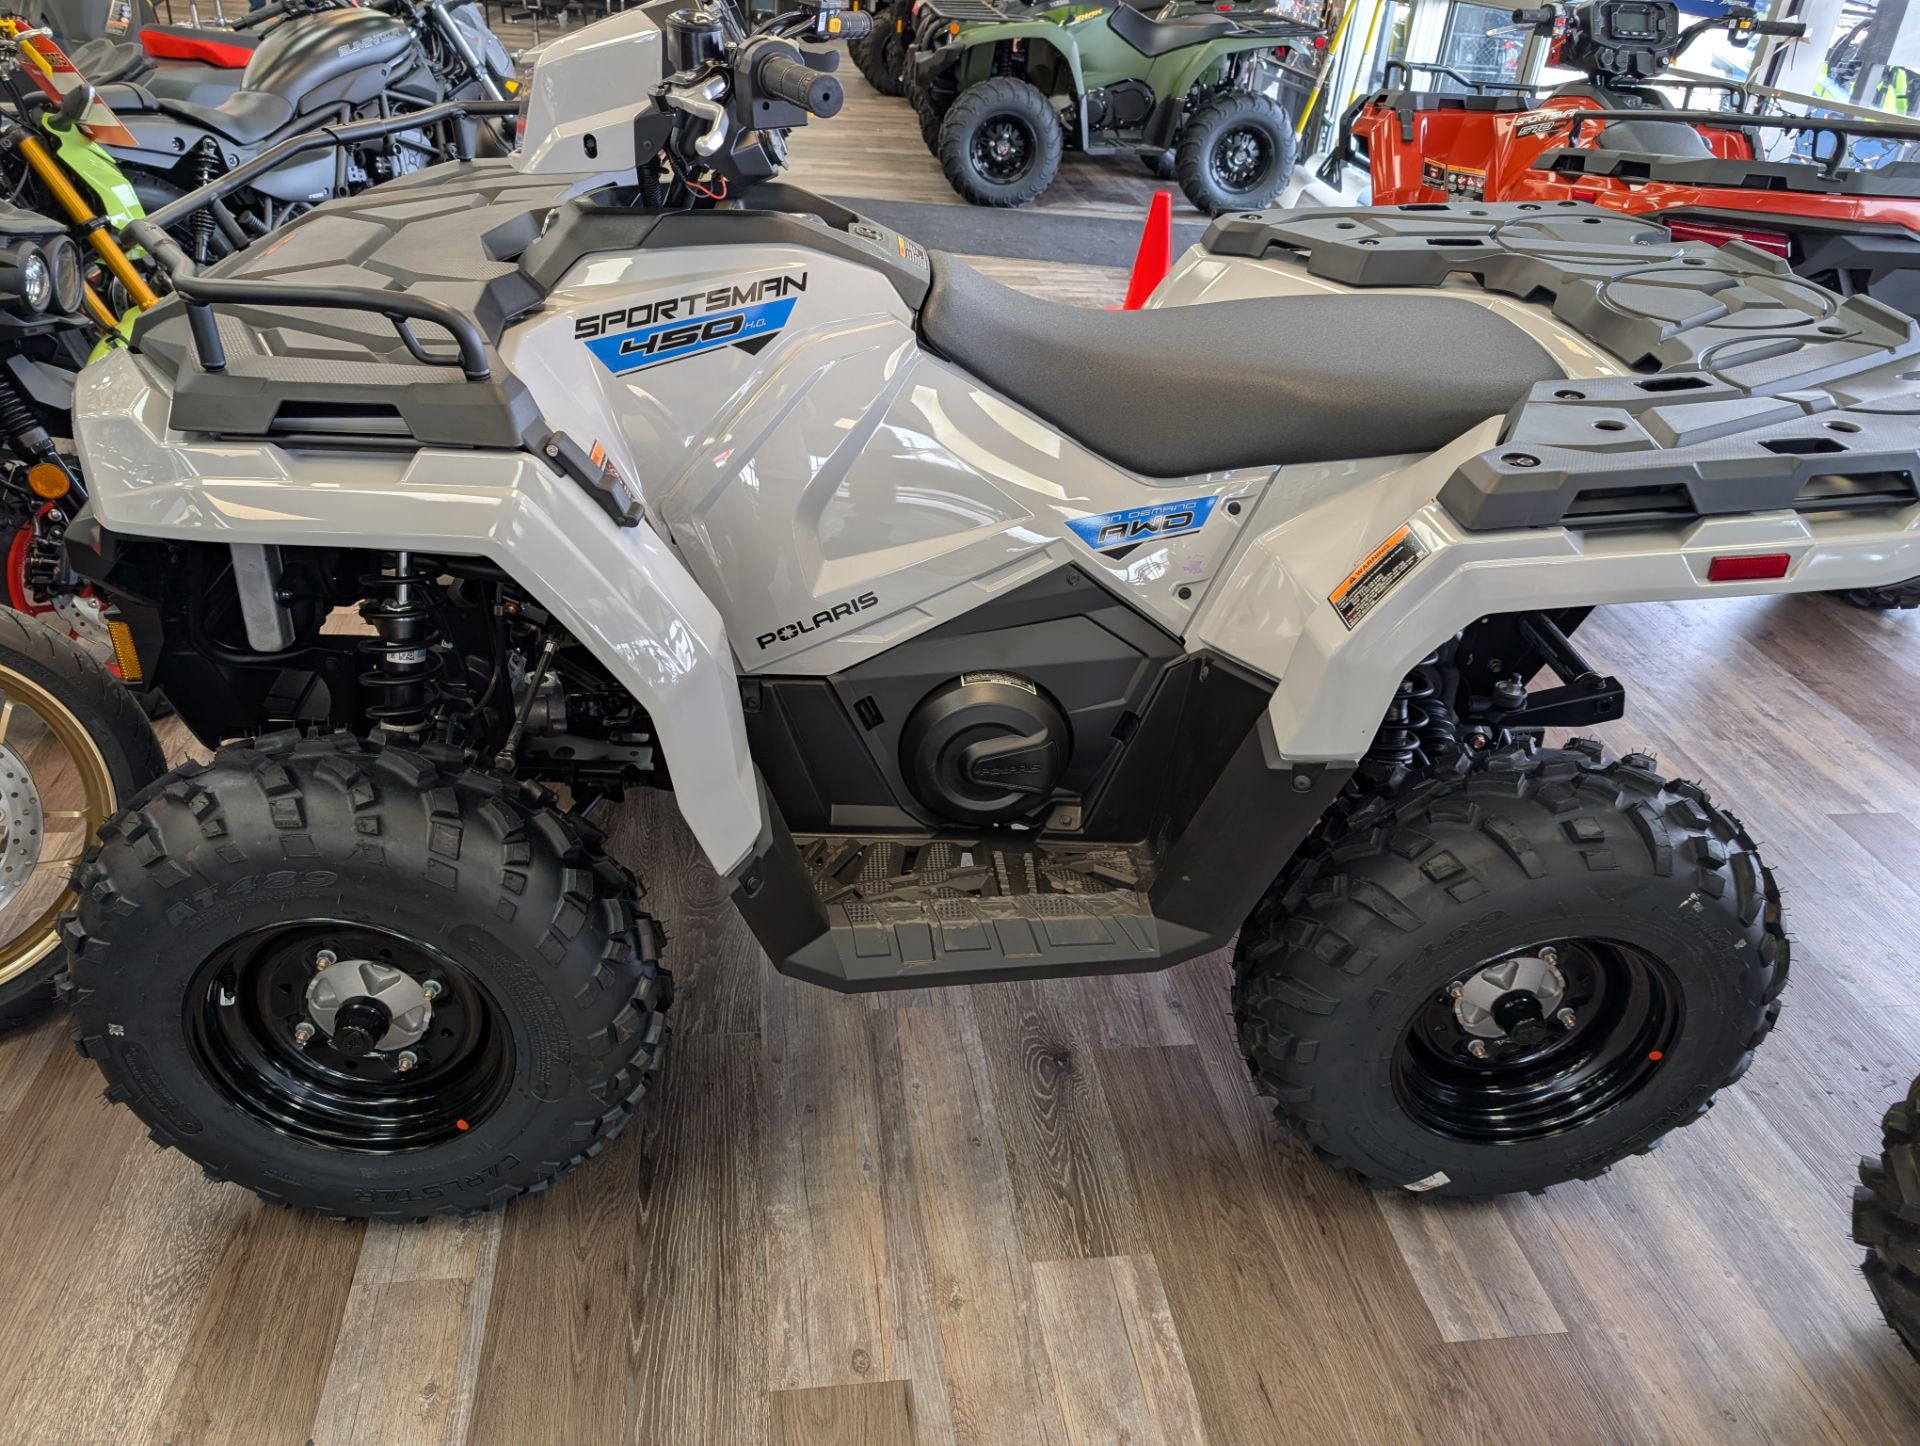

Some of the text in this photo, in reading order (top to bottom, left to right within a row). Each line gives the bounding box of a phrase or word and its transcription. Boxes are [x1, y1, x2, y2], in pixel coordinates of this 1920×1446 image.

[575, 272, 808, 340] SPORTSMAN
[619, 313, 745, 356] 450
[1097, 511, 1195, 544] AWD
[1128, 502, 1197, 519] DEMAND
[1355, 544, 1390, 576] WARNING
[756, 591, 879, 650] POLARIS
